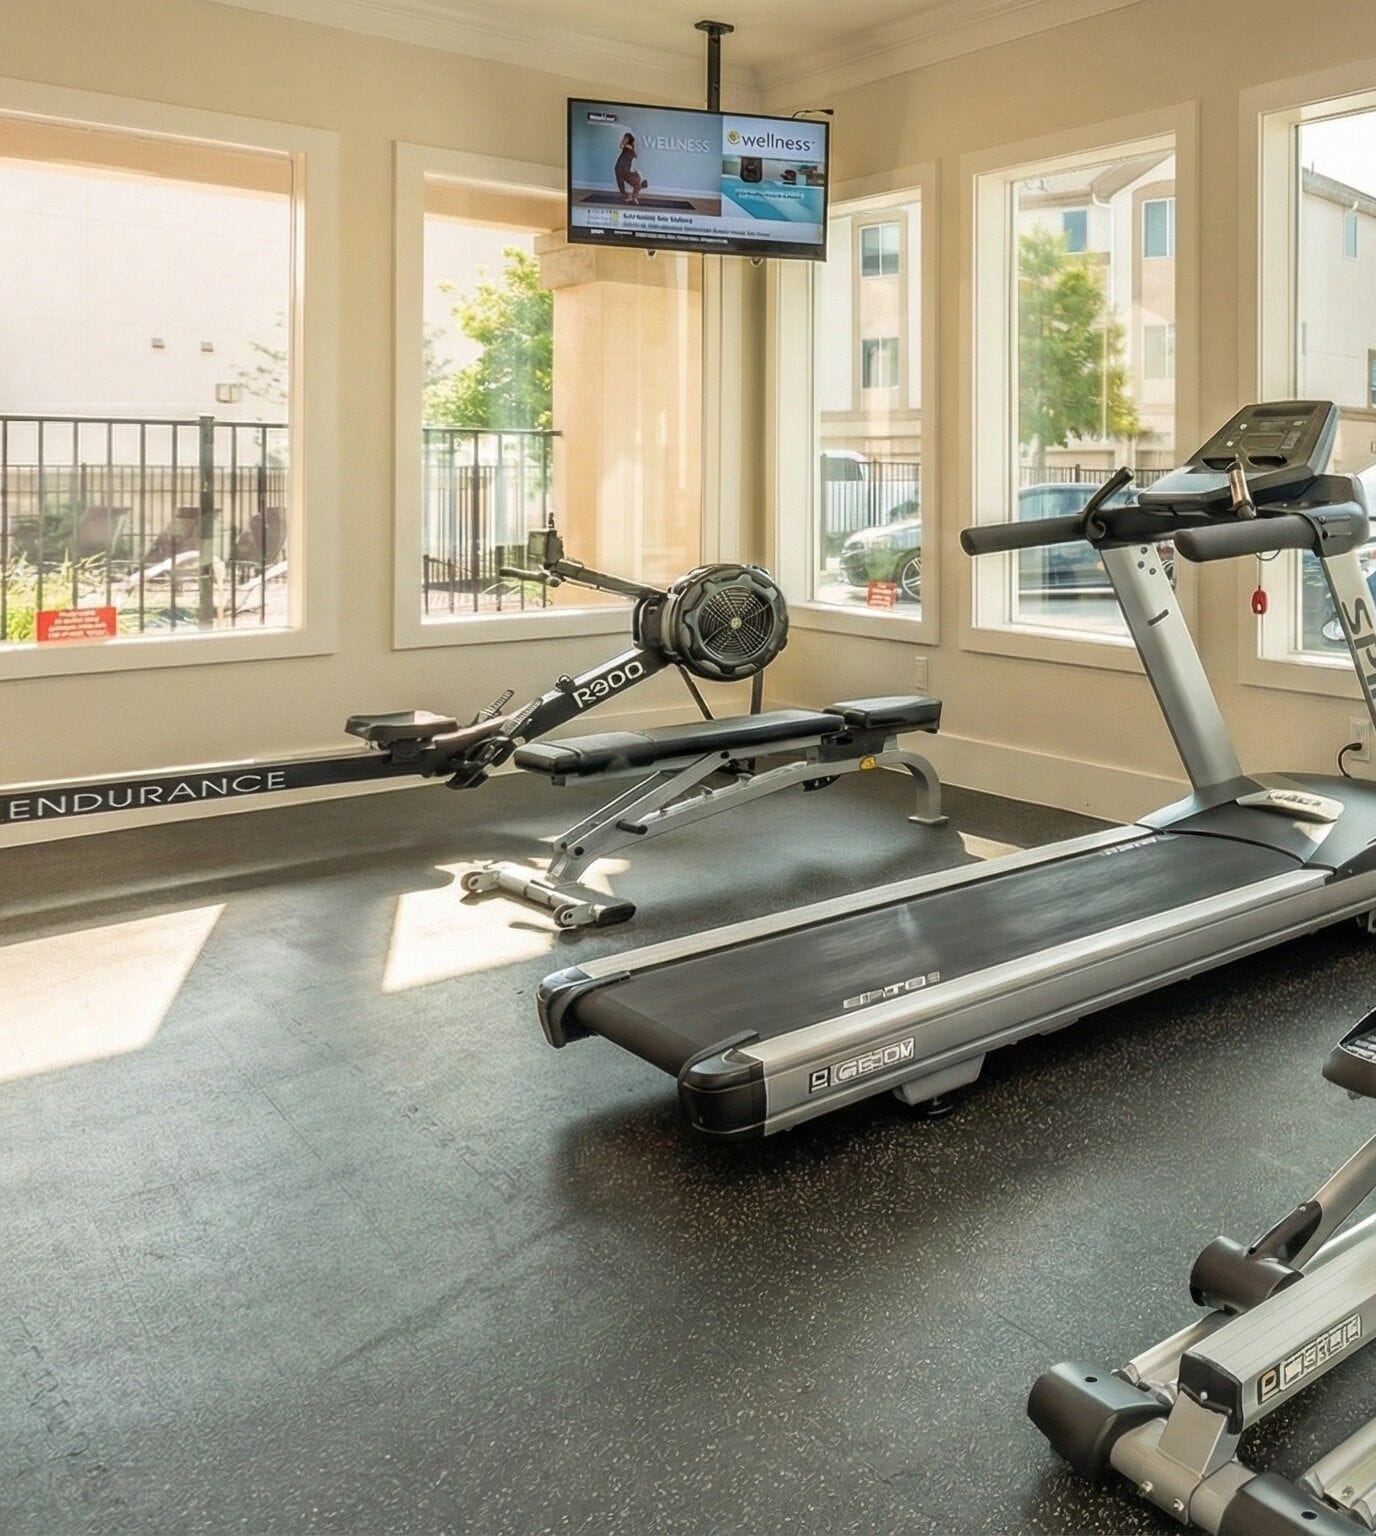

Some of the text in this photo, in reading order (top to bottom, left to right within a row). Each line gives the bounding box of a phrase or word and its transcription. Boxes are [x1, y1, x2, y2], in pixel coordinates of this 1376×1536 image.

[640, 135, 711, 153] WELLNESS
[741, 132, 811, 152] wellness
[9, 771, 287, 820] ENDURANCE
